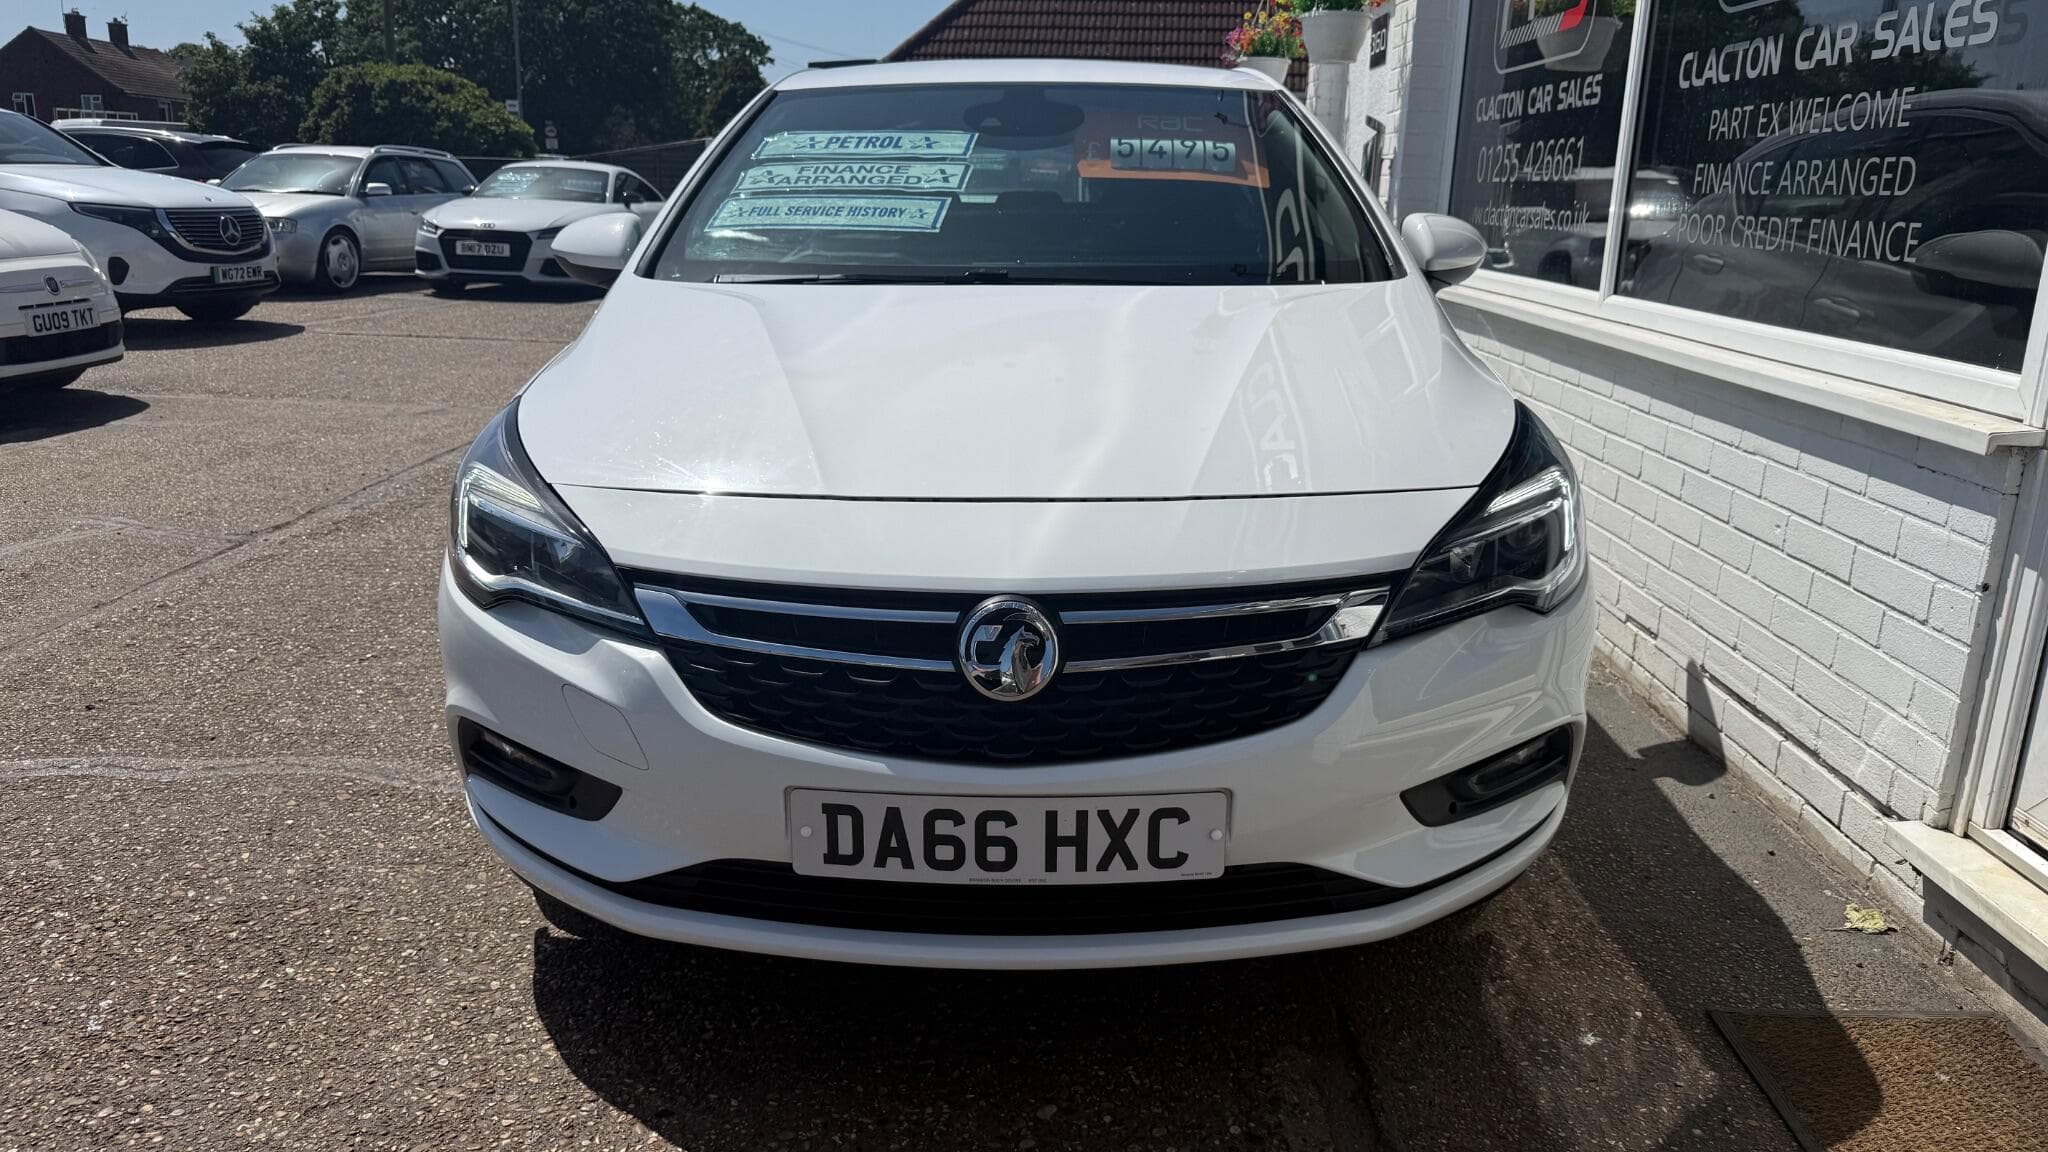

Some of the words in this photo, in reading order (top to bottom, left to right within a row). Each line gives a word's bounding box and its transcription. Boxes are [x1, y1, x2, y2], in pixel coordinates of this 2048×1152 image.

[1679, 33, 1784, 89] CLACTON
[1795, 20, 1859, 72] CAR
[1871, 0, 2000, 61] SALES
[1476, 90, 1524, 122] CLACTON
[1528, 83, 1554, 115] CAR
[1557, 73, 1603, 111] SALES
[1707, 104, 1754, 142] PART
[1757, 100, 1783, 138] EX
[1789, 86, 1916, 137] WELCOME
[823, 135, 904, 150] PETROL
[1477, 143, 1520, 183] 01255
[1523, 136, 1585, 182] 426661
[774, 174, 926, 187] ARRANGED
[796, 164, 911, 176] FINANCE
[1693, 160, 1774, 196] FINANCE
[1776, 155, 1917, 197] ARRANGED
[748, 206, 782, 217] FULL
[784, 206, 844, 218] SERVICE
[849, 206, 908, 219] HISTORY
[1676, 213, 1726, 246] POOR
[1730, 214, 1803, 252] CREDIT
[1806, 218, 1923, 264] FINANCE
[32, 311, 70, 333] GU09
[71, 307, 95, 328] TKT
[821, 803, 1019, 873] DA66
[1044, 806, 1191, 873] HXC
